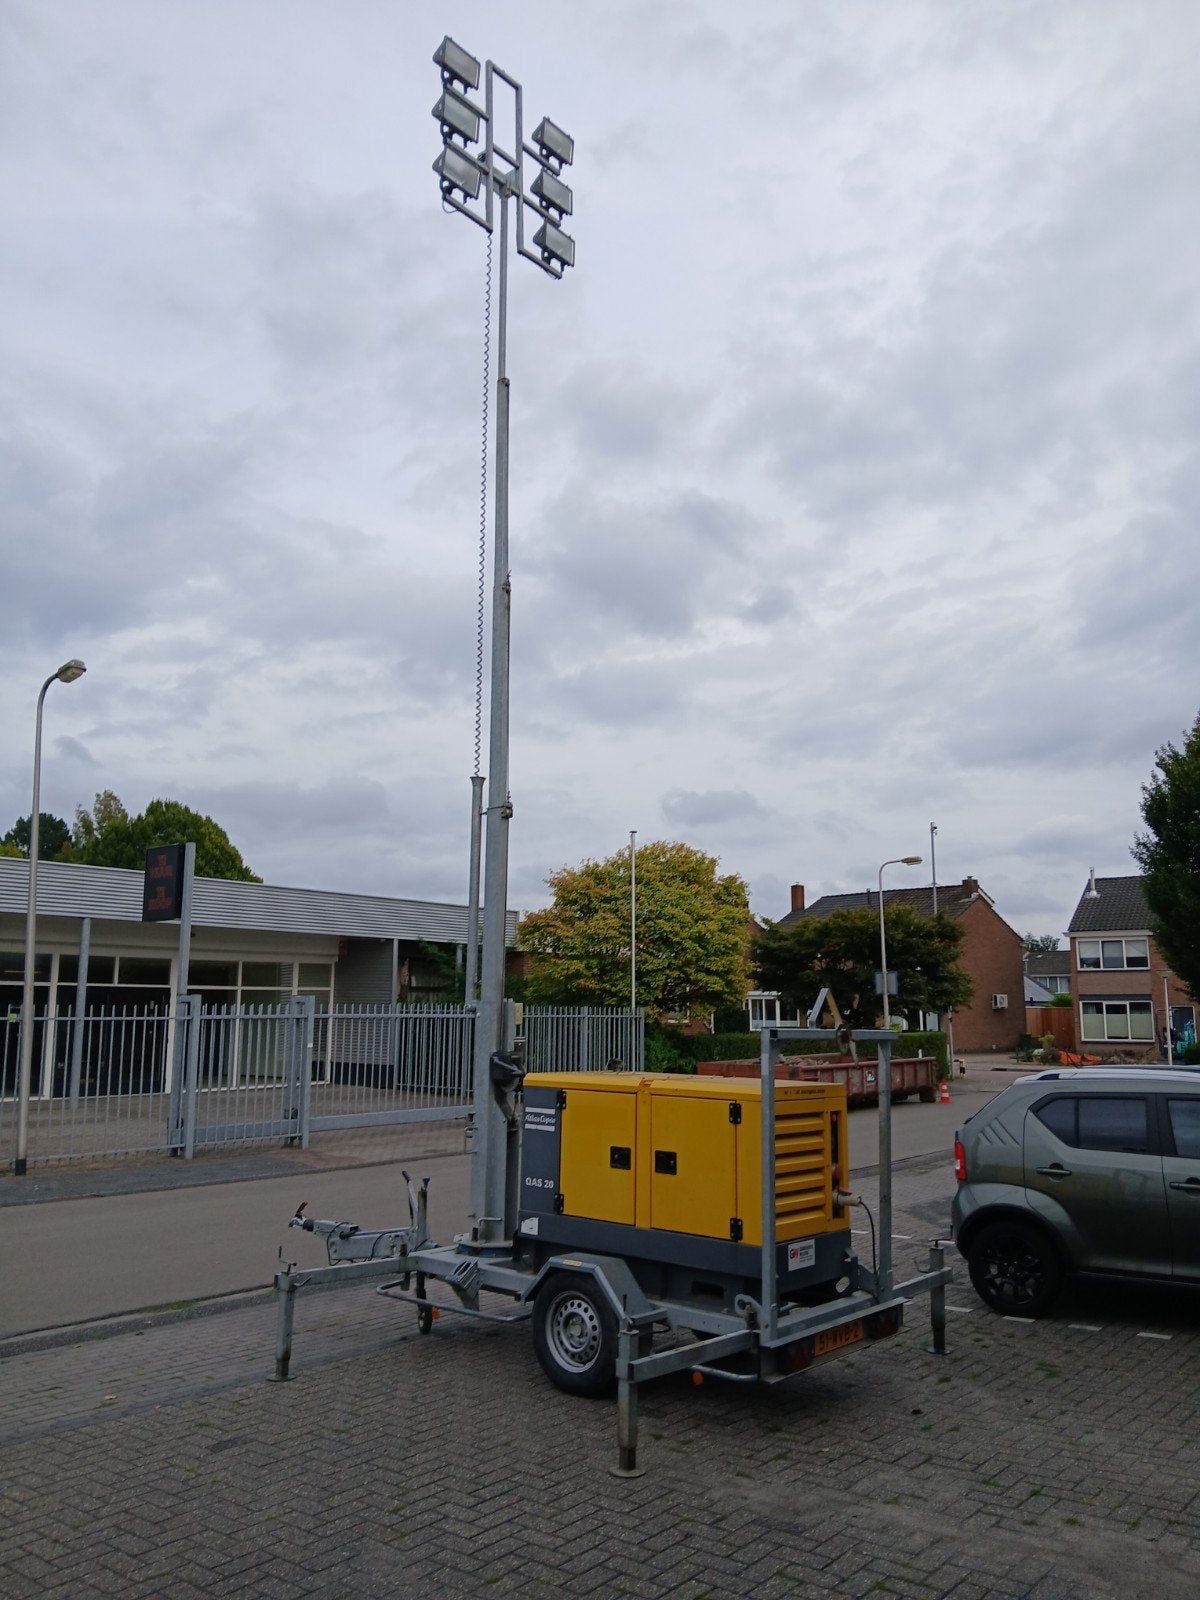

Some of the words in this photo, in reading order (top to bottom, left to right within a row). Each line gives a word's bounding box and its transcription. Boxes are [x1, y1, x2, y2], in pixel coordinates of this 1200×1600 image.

[525, 1114, 539, 1122] Atlas
[540, 1115, 555, 1124] Copco
[525, 1177, 542, 1187] QAS
[544, 1180, 554, 1188] 20
